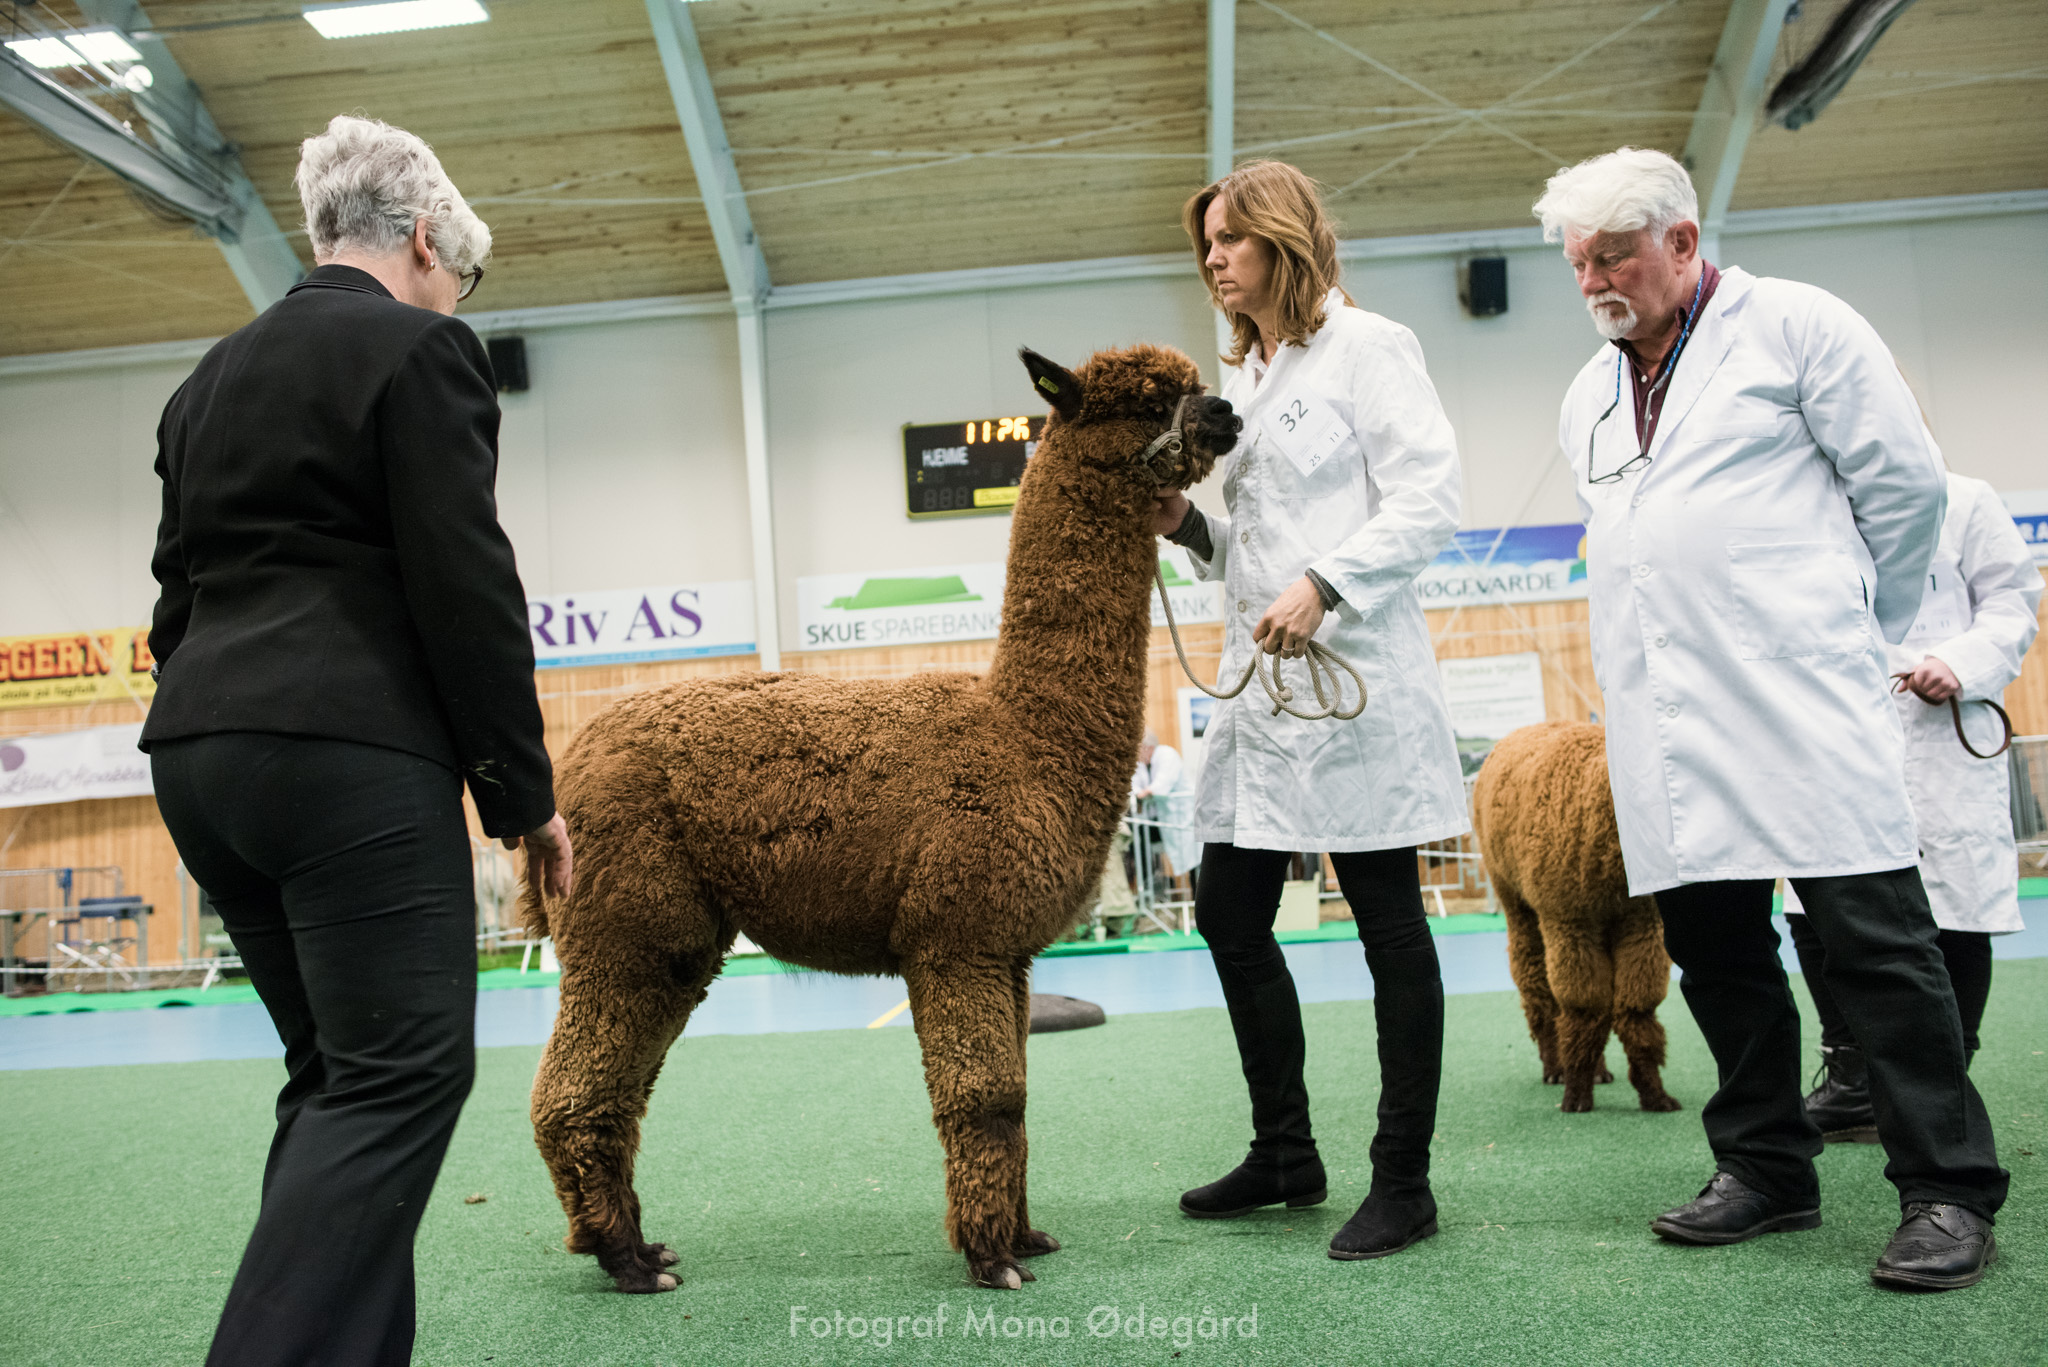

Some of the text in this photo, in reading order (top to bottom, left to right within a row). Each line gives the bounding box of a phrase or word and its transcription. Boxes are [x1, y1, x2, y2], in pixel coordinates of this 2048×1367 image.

[1279, 398, 1309, 433] 32
[1308, 431, 1340, 467] 25 11
[623, 588, 703, 643] AS
[806, 612, 1002, 645] SKUE SPAREBANK
